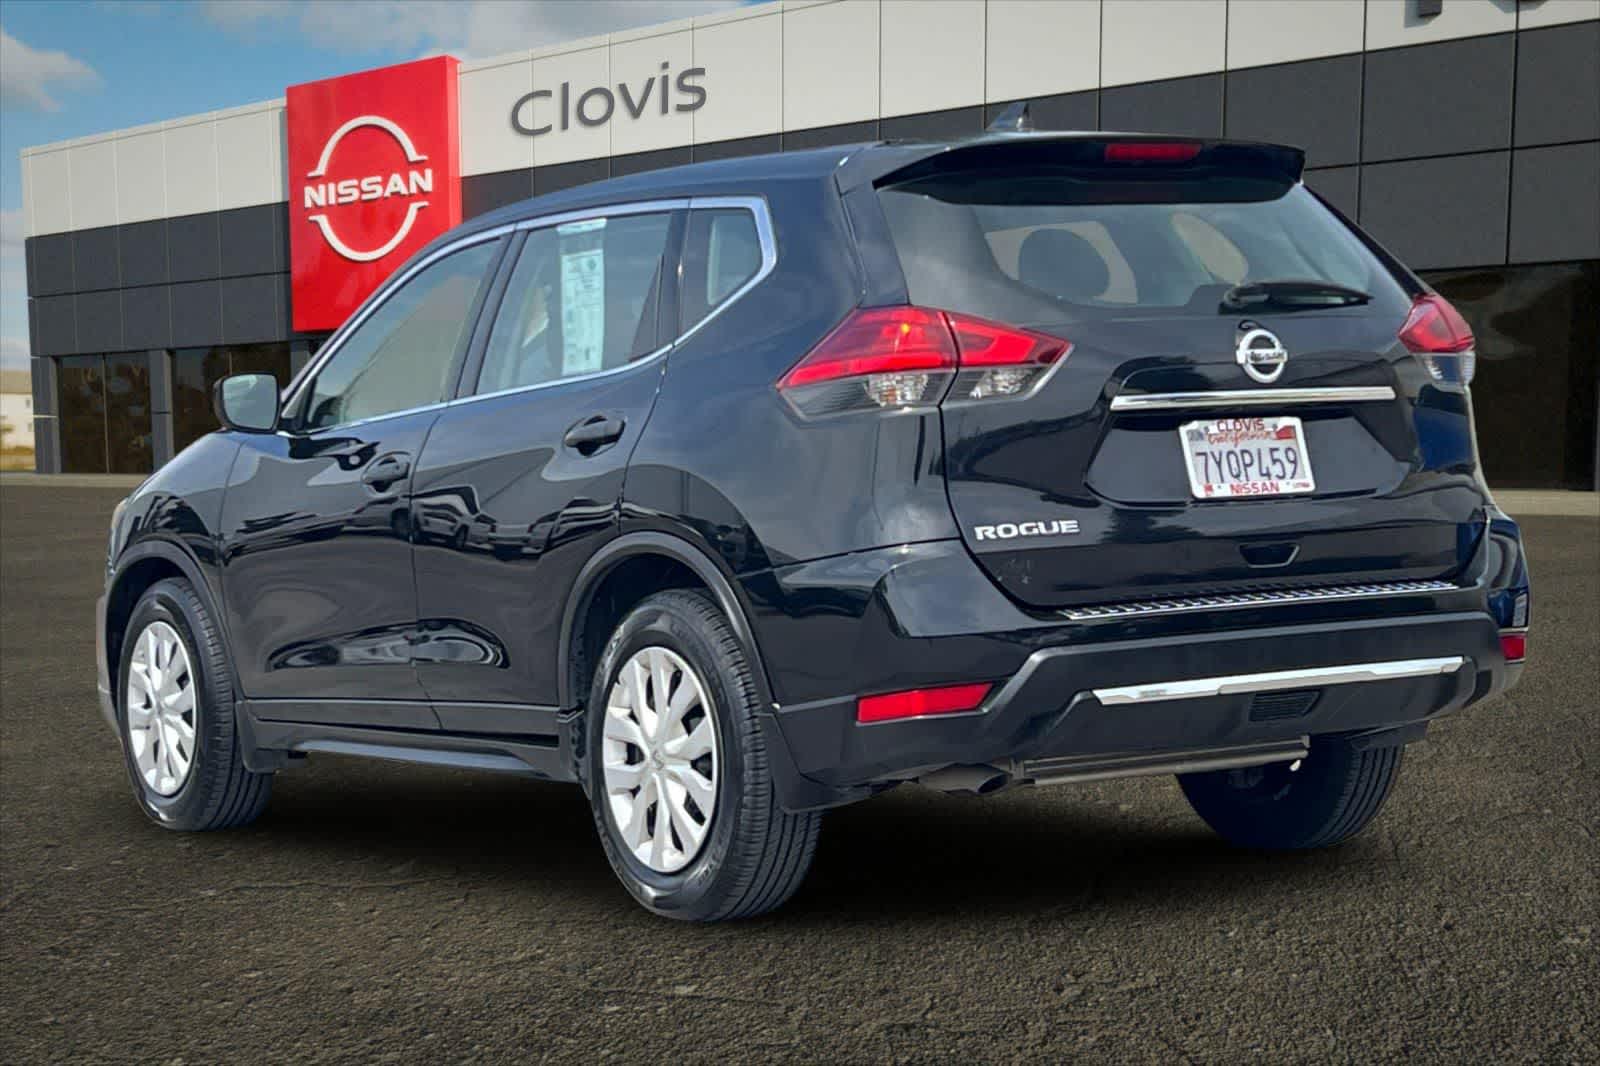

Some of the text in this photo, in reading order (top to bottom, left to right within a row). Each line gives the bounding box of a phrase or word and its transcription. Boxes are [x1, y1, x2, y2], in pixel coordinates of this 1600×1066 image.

[304, 169, 433, 208] NISSAN
[1216, 418, 1265, 432] CLOVIS
[1195, 447, 1298, 483] 7YQP459
[1230, 481, 1280, 495] NISSAN
[974, 519, 1081, 541] ROGUE
